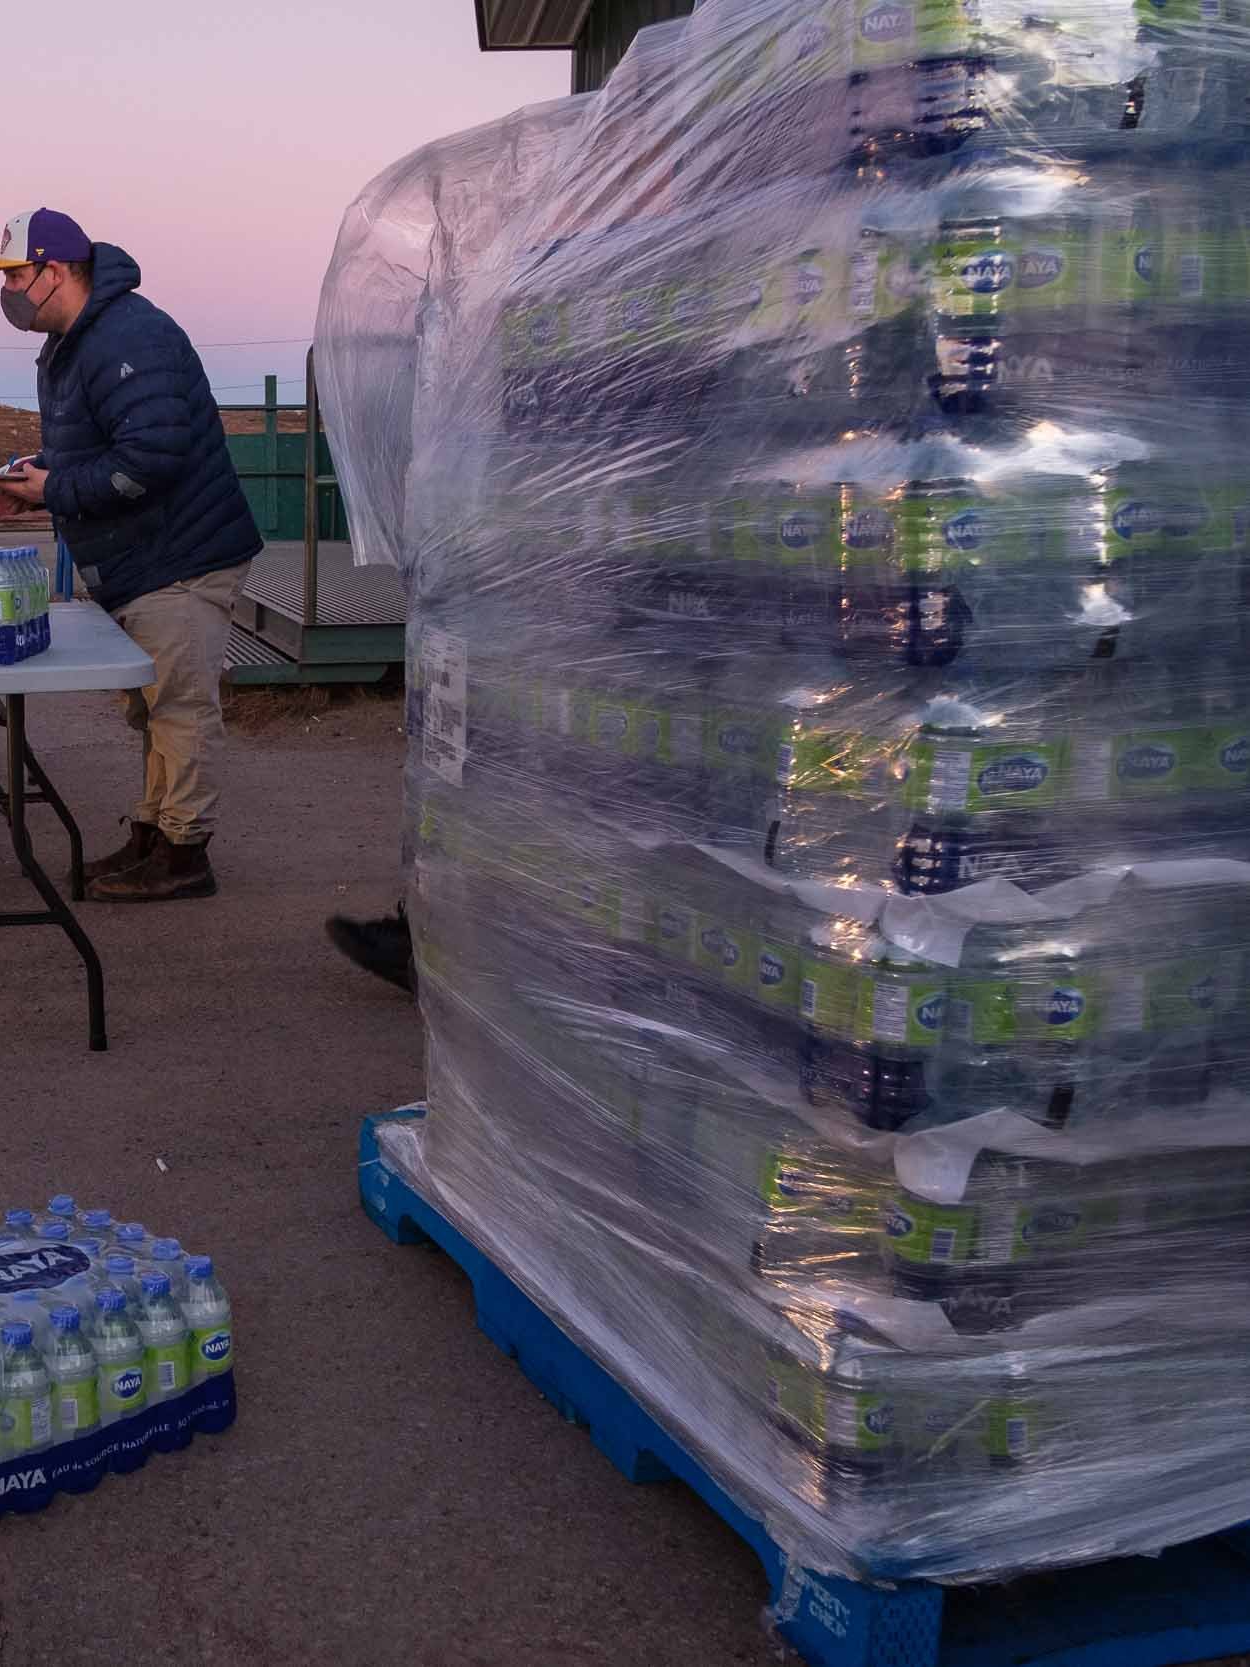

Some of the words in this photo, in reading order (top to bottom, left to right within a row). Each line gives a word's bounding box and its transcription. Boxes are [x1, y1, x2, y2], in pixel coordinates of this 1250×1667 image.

[922, 1006, 943, 1018] NA
[1052, 1001, 1080, 1015] AYA
[205, 1340, 230, 1354] NAYA
[114, 1376, 141, 1391] NAYA
